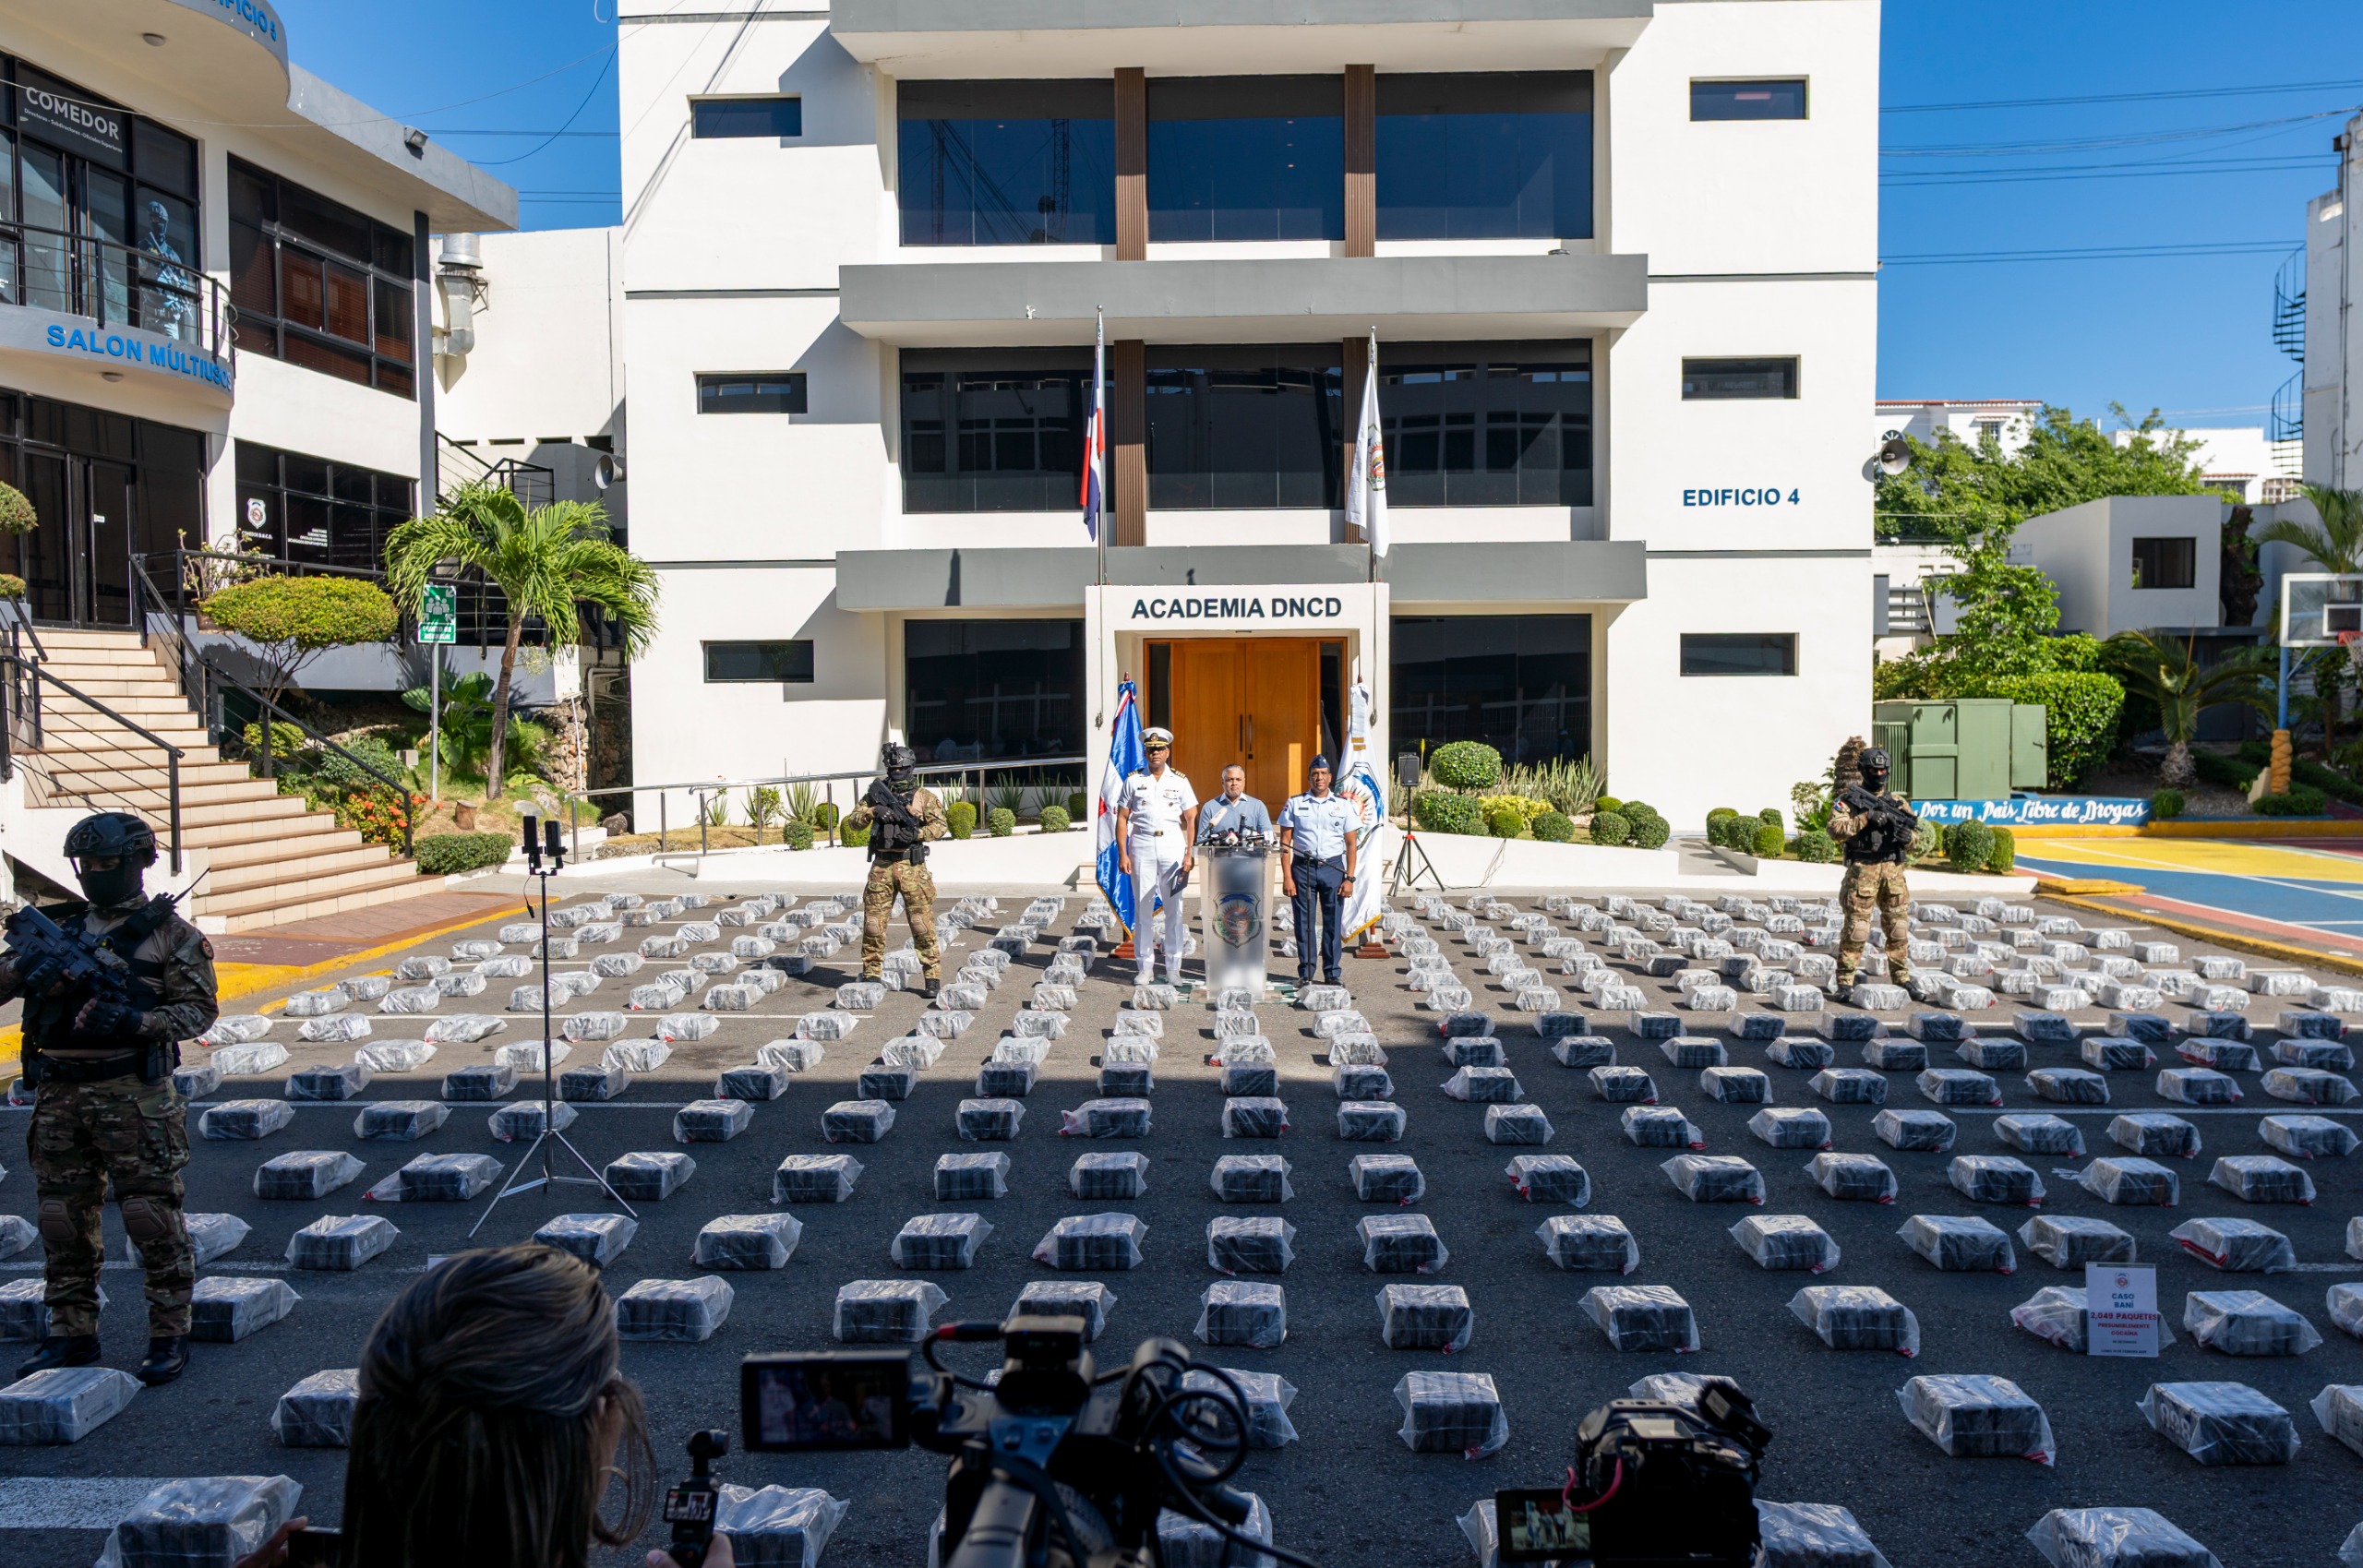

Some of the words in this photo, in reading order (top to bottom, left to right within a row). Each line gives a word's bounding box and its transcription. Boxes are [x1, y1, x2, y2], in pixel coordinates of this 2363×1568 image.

[26, 87, 119, 140] COMEDOR
[47, 325, 141, 361] SALON
[1683, 488, 1781, 507] EDIFICIO
[1787, 488, 1800, 505] 4
[1131, 598, 1265, 619] ACADEMIA
[1271, 597, 1342, 617] DNCD
[1951, 802, 1973, 820] un
[2015, 800, 2059, 824] Libre
[2061, 801, 2080, 819] de
[2078, 800, 2149, 824] Drogas
